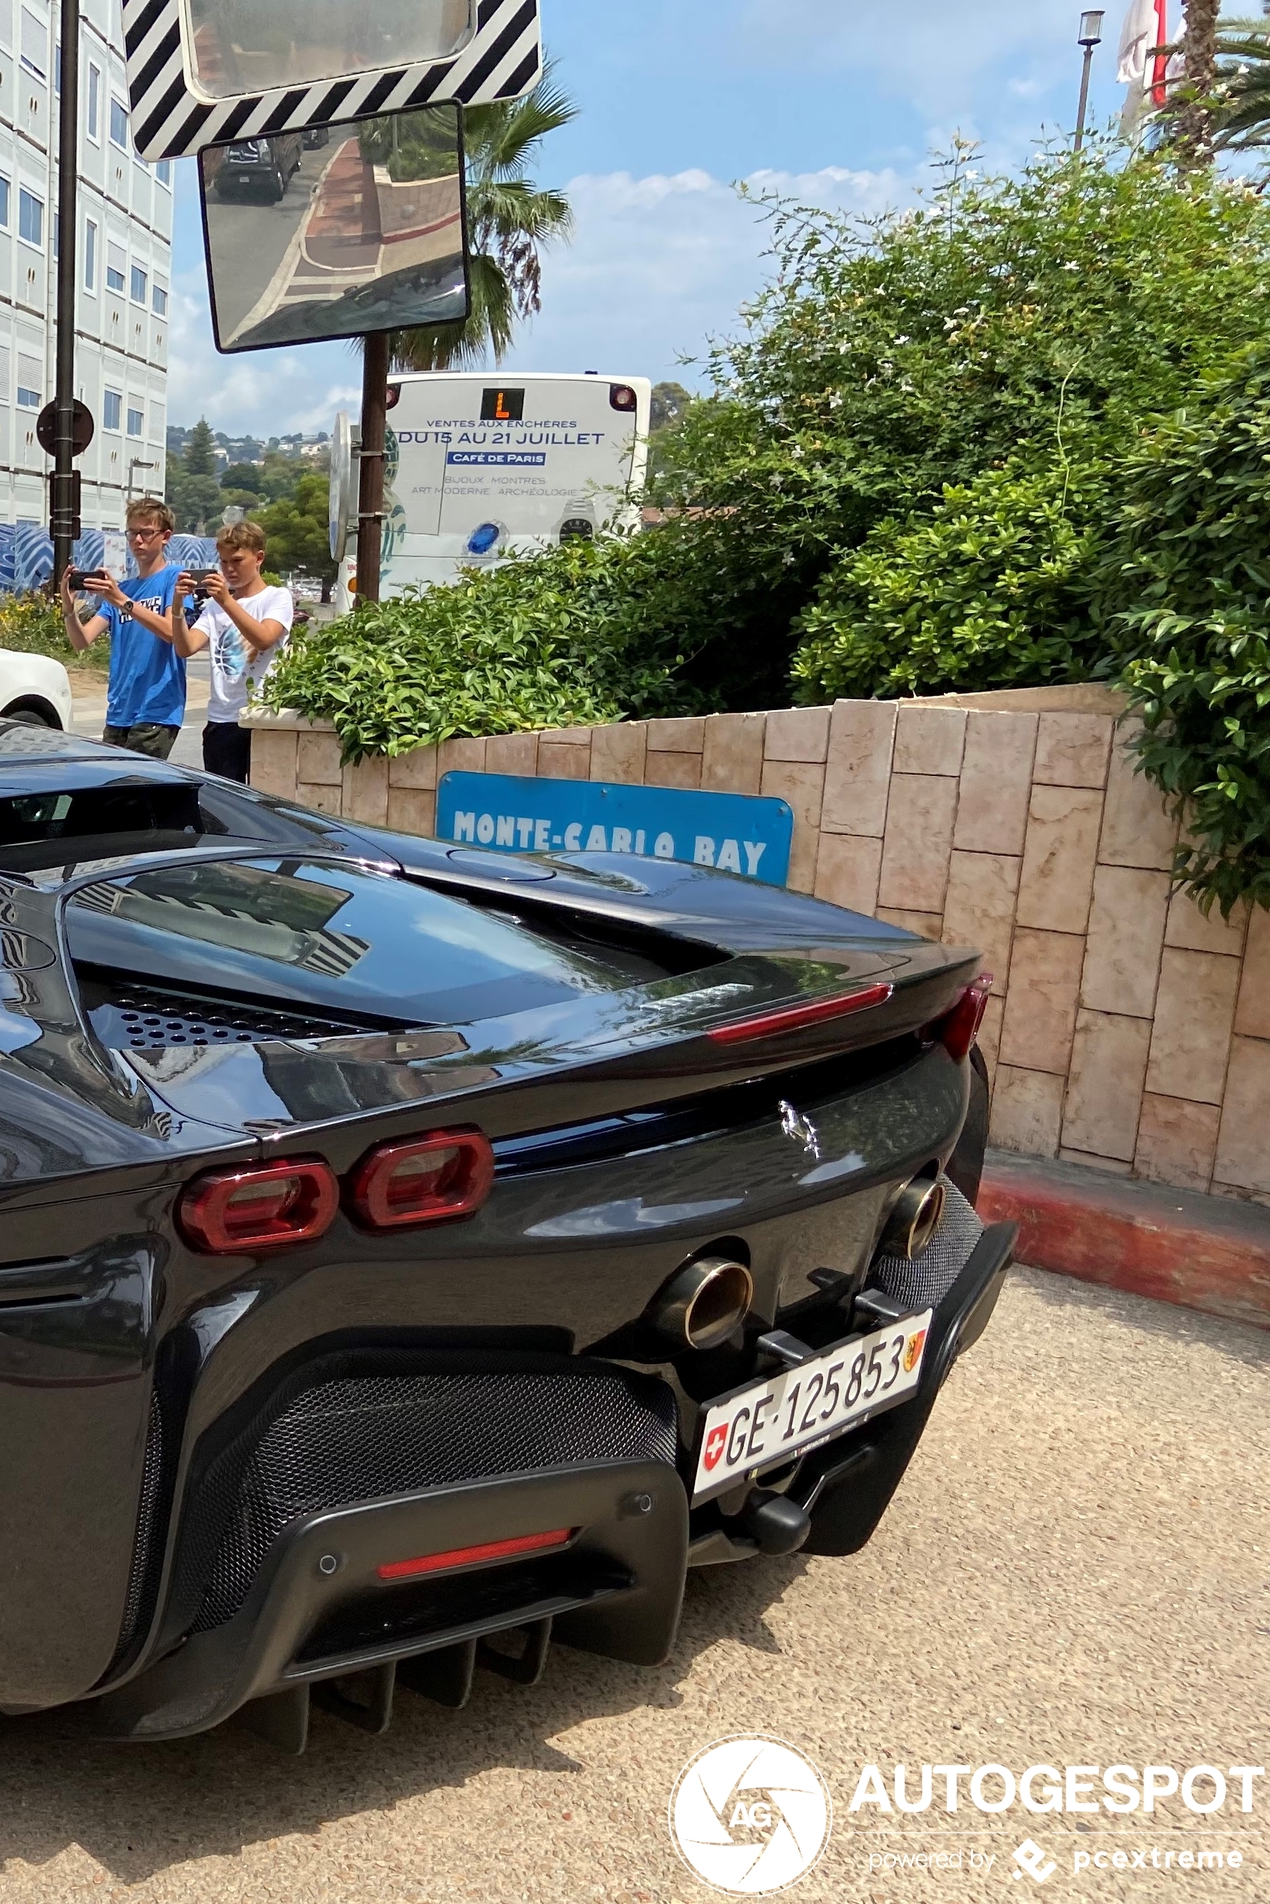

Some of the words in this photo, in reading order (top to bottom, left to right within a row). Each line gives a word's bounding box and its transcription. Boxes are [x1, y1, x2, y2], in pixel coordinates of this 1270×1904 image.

[495, 392, 509, 418] L
[427, 420, 475, 428] VENTES
[478, 420, 504, 428] AUX
[507, 419, 577, 429] ENCHÈRES
[398, 432, 429, 443] DU
[434, 432, 452, 443] 15
[457, 432, 487, 444] AU
[491, 433, 510, 444] 21
[515, 433, 605, 445] JUILLET
[507, 454, 544, 464] PARIS
[444, 476, 484, 484] BIJOUX
[491, 477, 546, 485] MONTRES
[411, 487, 432, 495] ART
[434, 487, 490, 496] MODERNE
[453, 810, 676, 858] MONTE-CARLO
[693, 835, 767, 876] BAY
